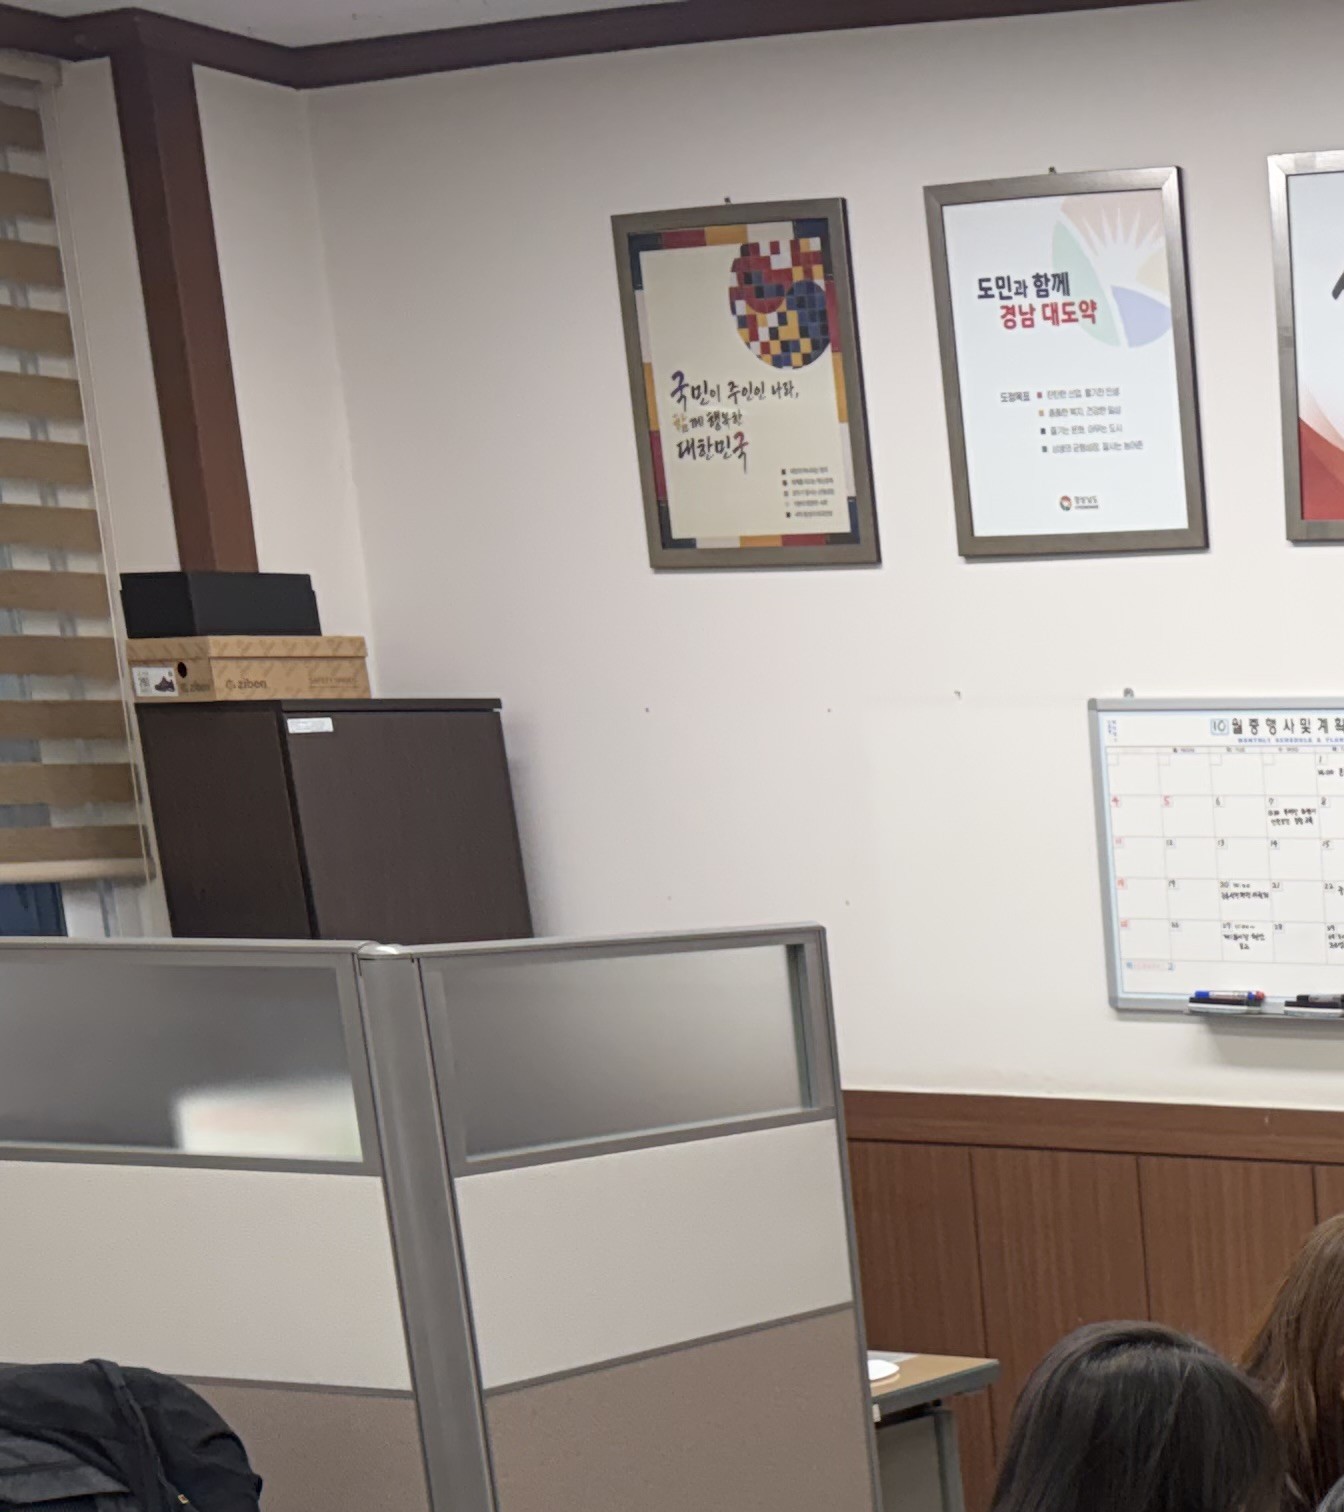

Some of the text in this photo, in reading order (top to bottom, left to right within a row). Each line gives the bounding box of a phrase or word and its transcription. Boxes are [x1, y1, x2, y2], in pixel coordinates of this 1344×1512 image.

[977, 271, 1070, 300] 도민과 함께
[999, 299, 1098, 330] 경남 대도약
[670, 370, 800, 412] 국민이 주인인 나라,
[673, 410, 743, 433] 함께 행복한
[677, 431, 750, 474] 대한민국
[237, 677, 267, 689] ziben
[1213, 720, 1226, 732] 10
